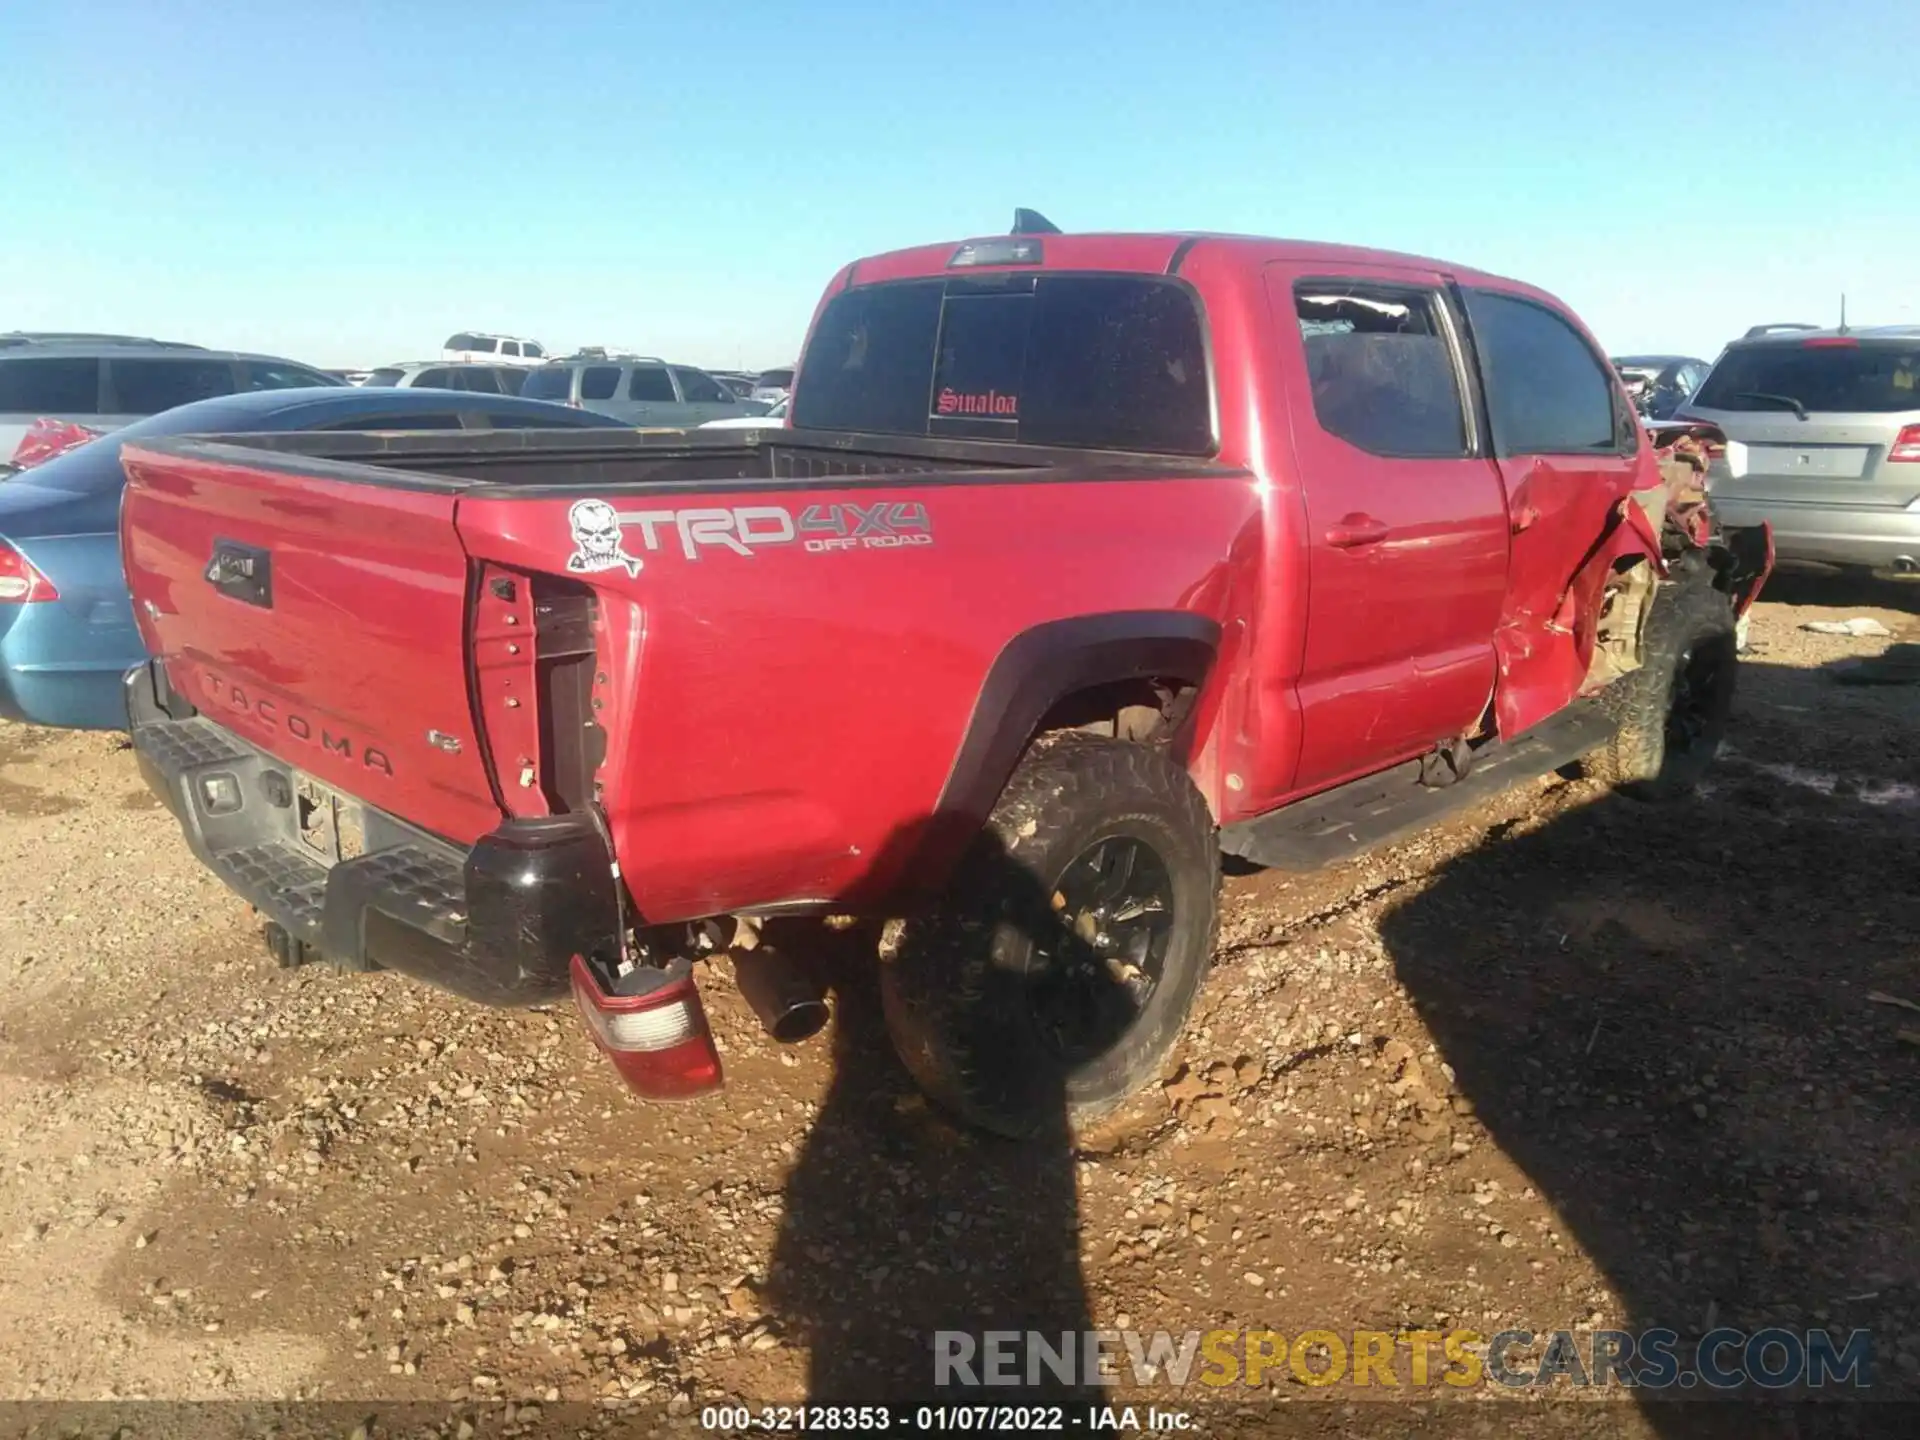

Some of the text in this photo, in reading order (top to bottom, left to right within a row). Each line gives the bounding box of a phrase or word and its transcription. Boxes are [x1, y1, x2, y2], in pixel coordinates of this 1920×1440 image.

[938, 387, 1017, 414] Sinaloa
[618, 506, 796, 560] TRD
[804, 534, 933, 553] OFF ROAD
[205, 672, 394, 778] TACOMA
